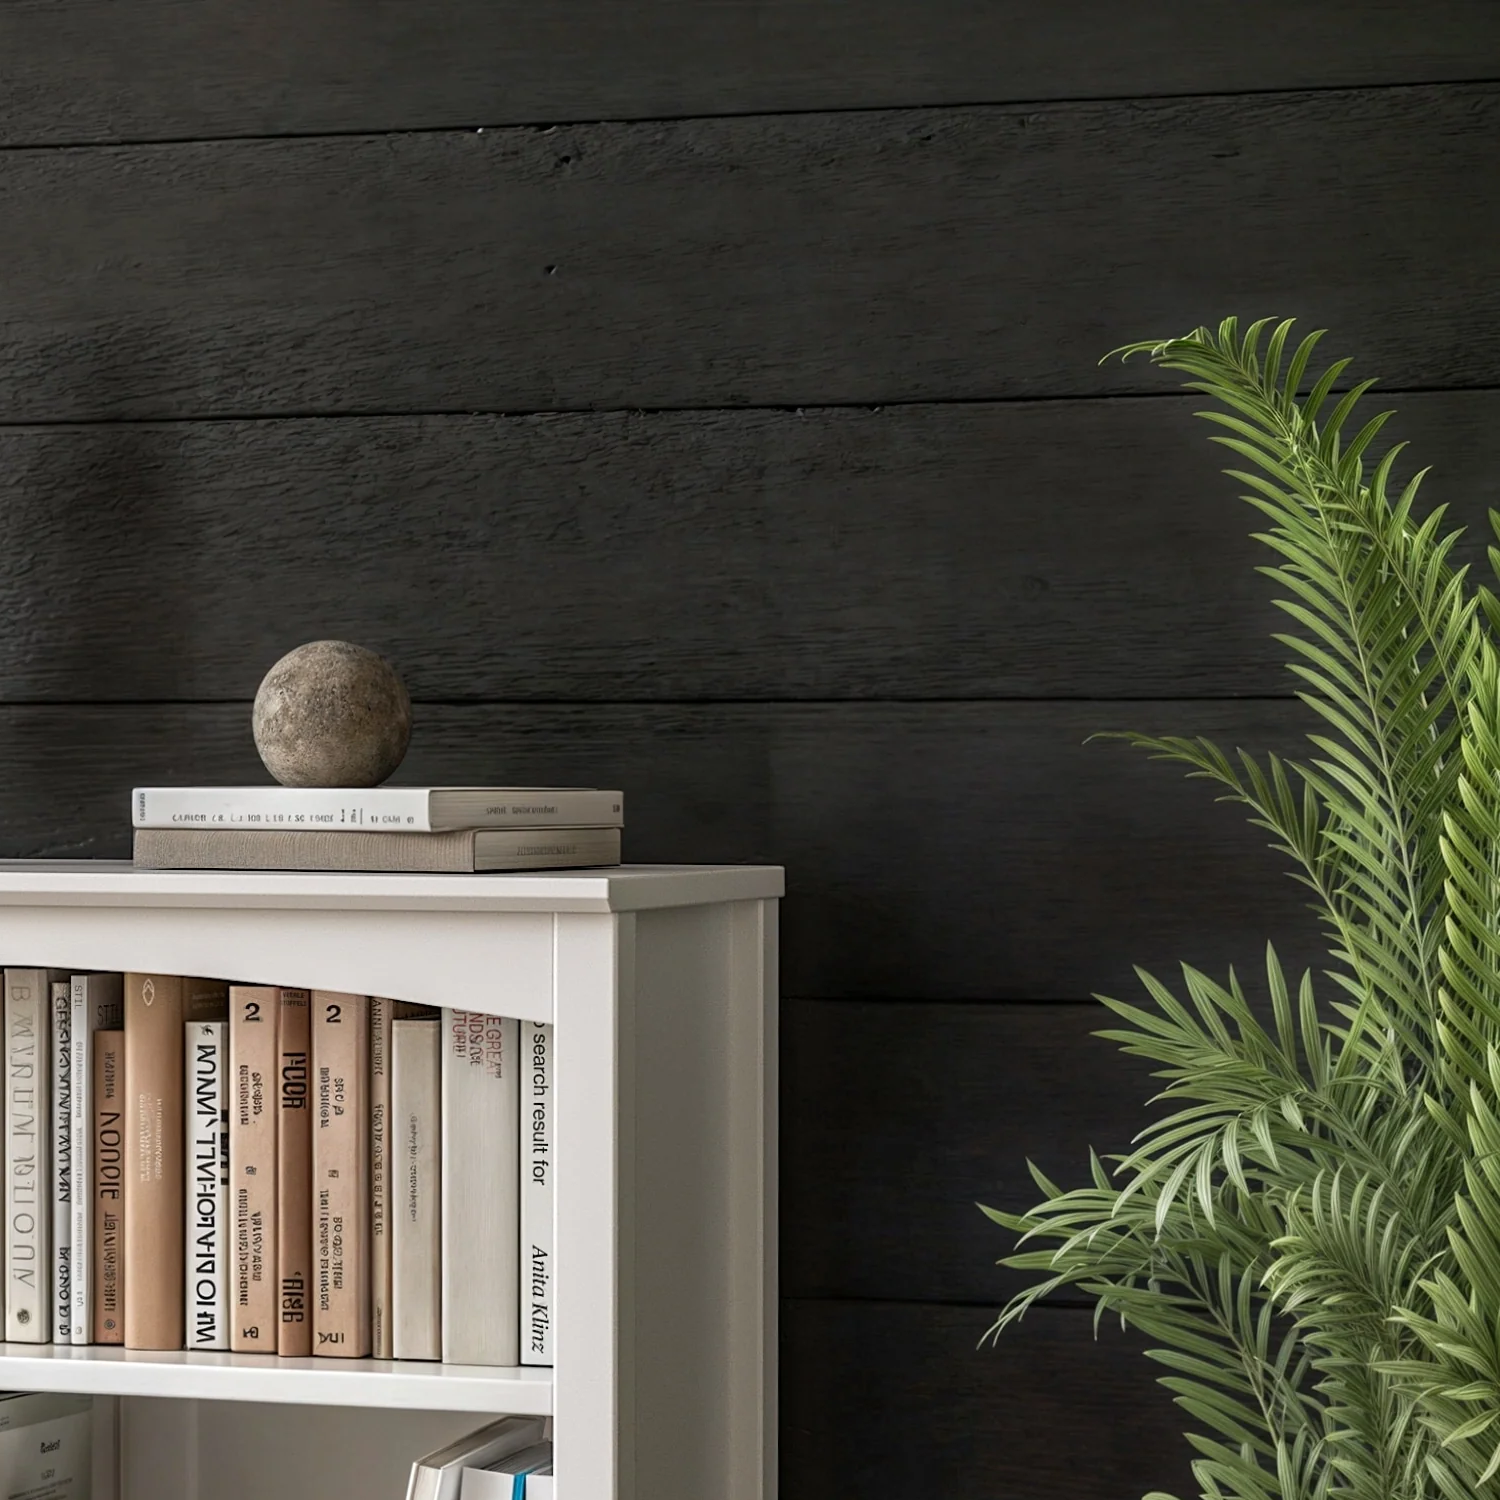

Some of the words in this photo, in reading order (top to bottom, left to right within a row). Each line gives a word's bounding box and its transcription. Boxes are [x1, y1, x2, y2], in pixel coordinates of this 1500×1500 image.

[245, 1003, 260, 1021] 2
[326, 1004, 342, 1023] 2
[533, 1034, 548, 1096] search
[533, 1102, 548, 1153] result
[533, 1160, 549, 1186] for
[532, 1245, 548, 1297] Anita
[532, 1301, 550, 1353] Klinz
